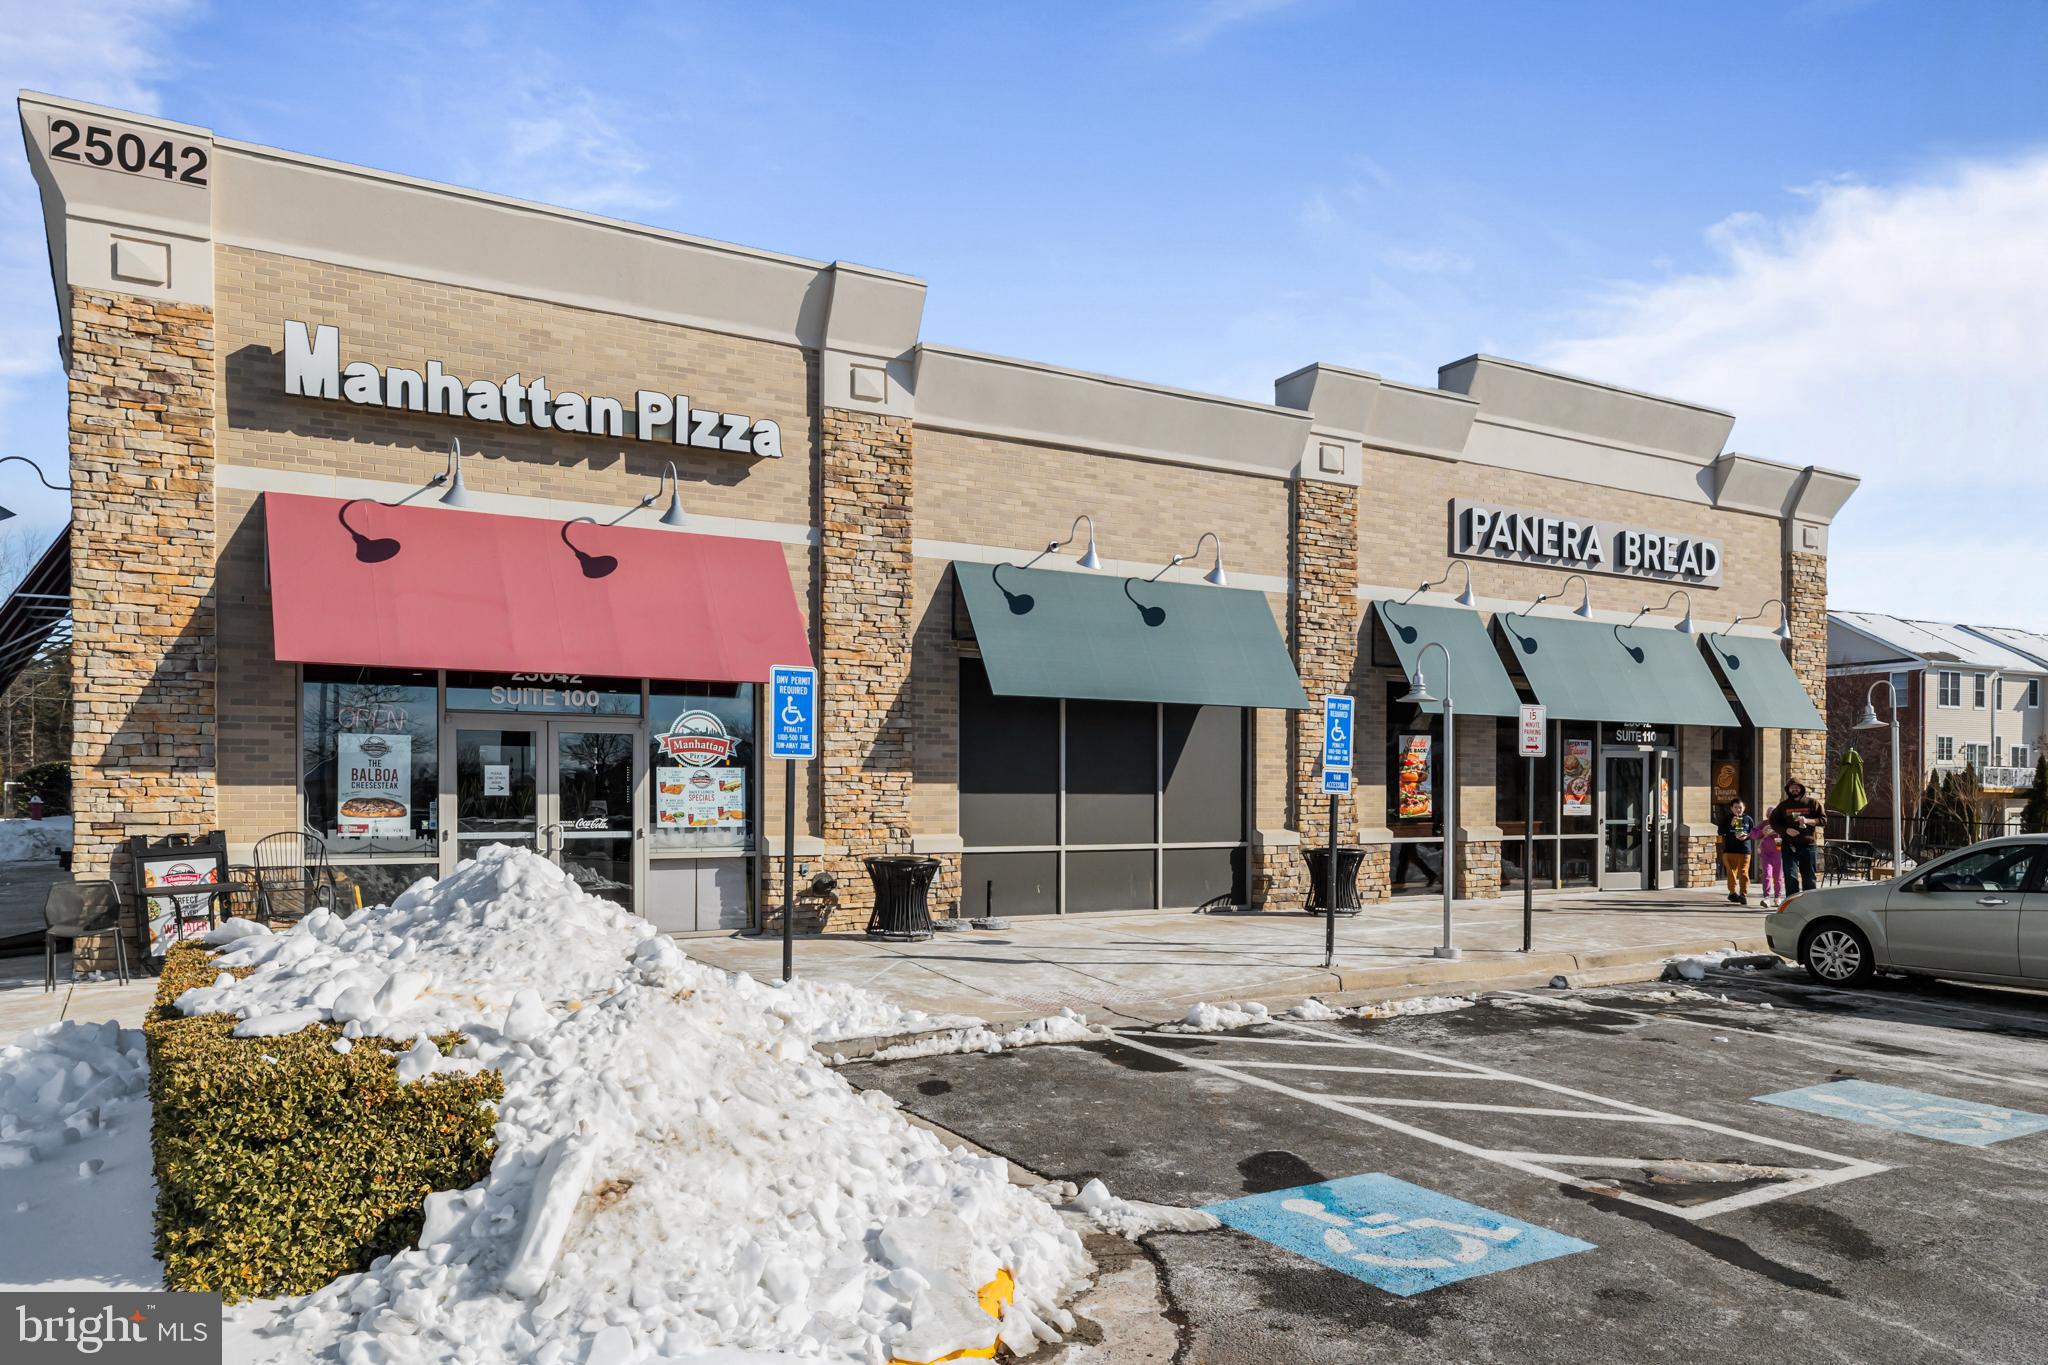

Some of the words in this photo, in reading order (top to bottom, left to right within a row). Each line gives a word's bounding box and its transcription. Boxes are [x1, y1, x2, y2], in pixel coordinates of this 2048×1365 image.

[50, 119, 208, 186] 25042
[283, 319, 624, 438] Manhattan
[1470, 507, 1605, 563] PANERA
[1622, 530, 1720, 577] BREAD
[791, 676, 811, 686] PERMIT
[490, 685, 556, 706] SUITE
[561, 689, 600, 707] 100
[779, 685, 808, 695] REQUIRED
[338, 705, 405, 731] OPEN
[1529, 711, 1537, 721] 15
[1523, 728, 1541, 736] PARKING
[1615, 729, 1641, 742] SUITE
[1642, 730, 1657, 743] 110
[673, 738, 725, 753] Manhattan
[368, 759, 382, 767] THE
[351, 768, 399, 781] BALBOA
[351, 781, 399, 790] CHEESESTEAK
[688, 794, 715, 802] SPECIALS
[169, 895, 199, 905] PRFECT
[163, 923, 179, 934] WE
[182, 920, 208, 933] ATER
